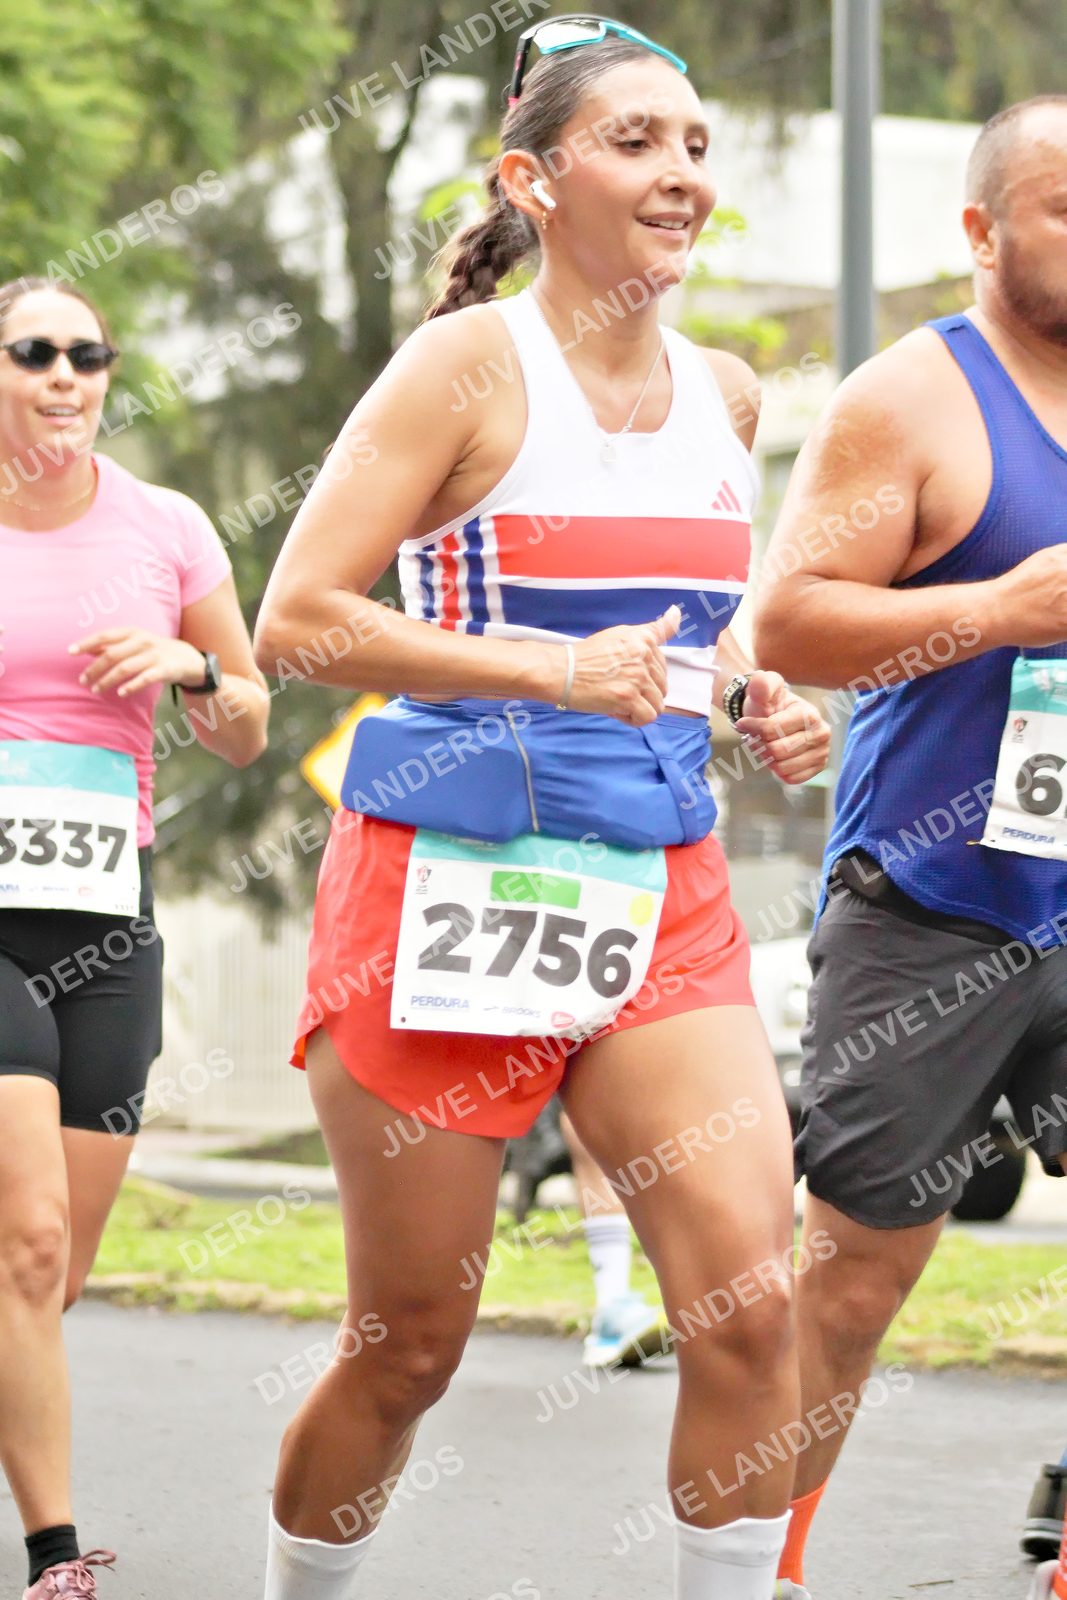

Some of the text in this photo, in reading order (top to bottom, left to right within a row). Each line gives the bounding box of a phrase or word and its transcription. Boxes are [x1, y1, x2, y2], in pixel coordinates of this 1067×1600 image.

[1002, 827, 1055, 843] PERDURA
[417, 902, 639, 999] 2756
[410, 995, 470, 1009] PERDURA
